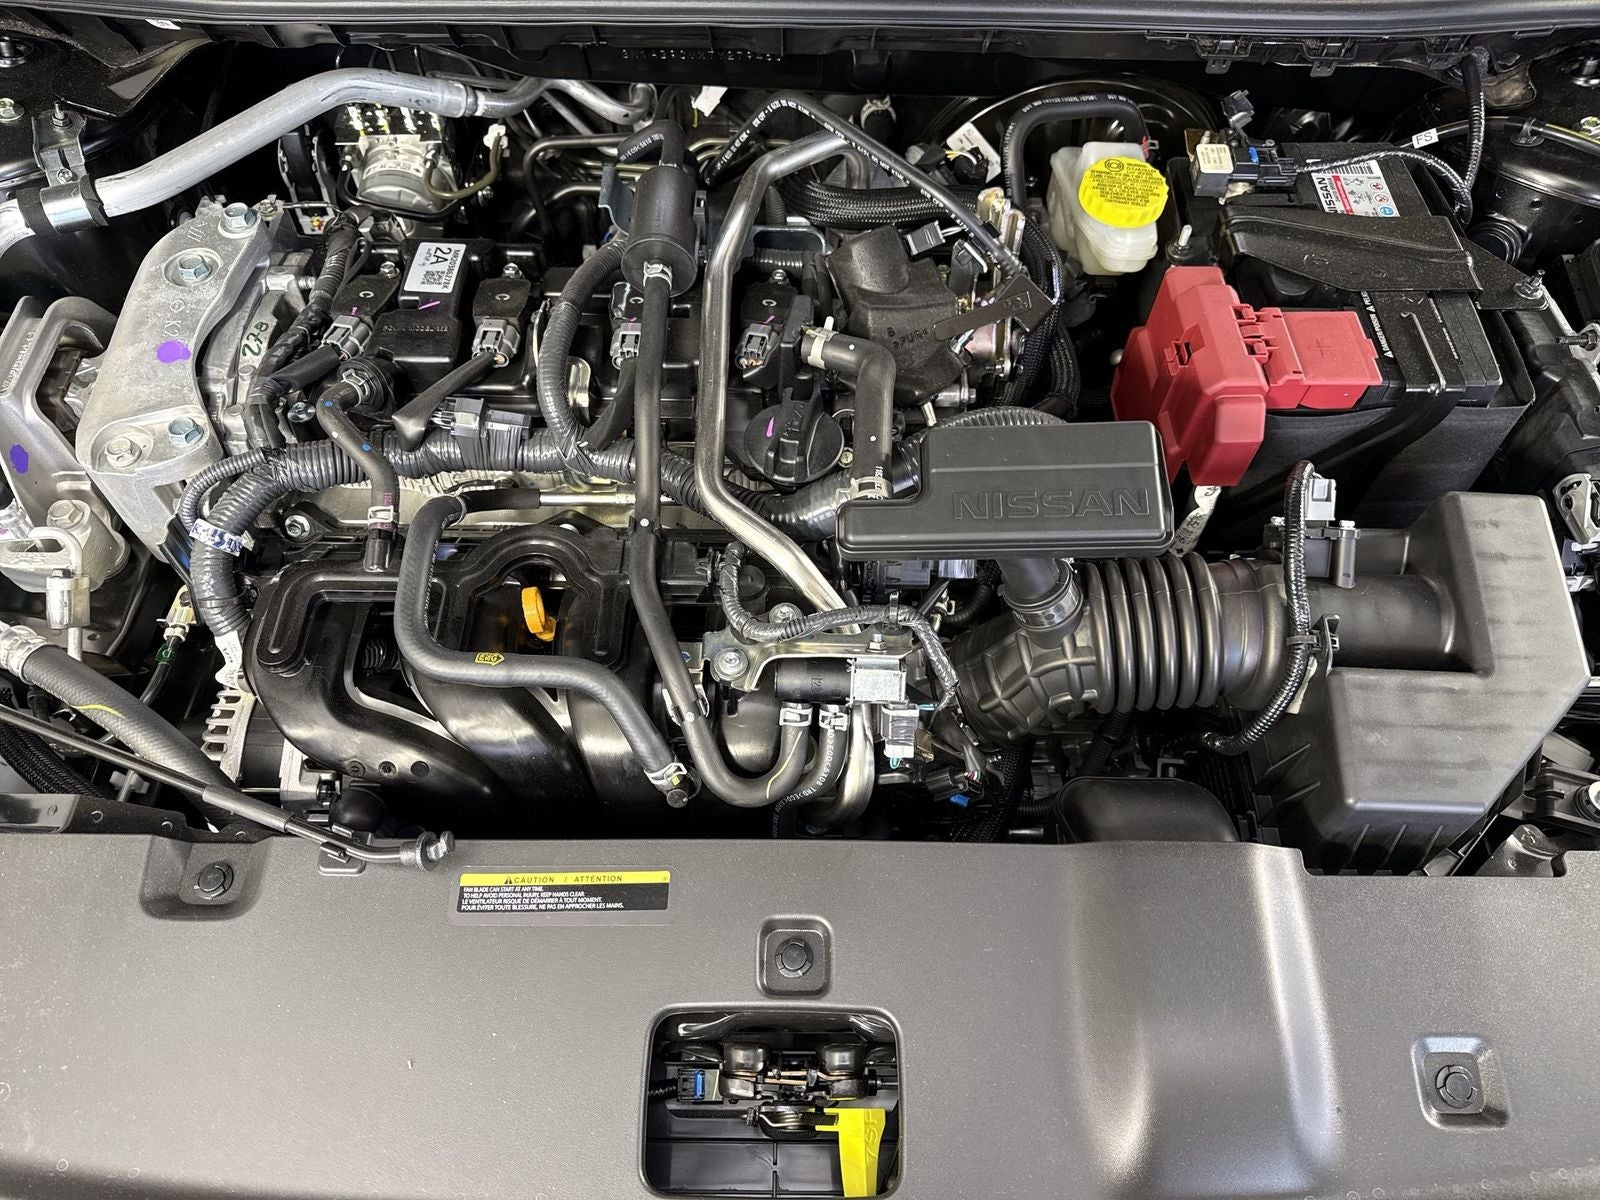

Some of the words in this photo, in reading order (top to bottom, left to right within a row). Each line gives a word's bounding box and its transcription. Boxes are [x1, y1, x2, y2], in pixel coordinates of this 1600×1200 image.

[1416, 131, 1433, 145] FS
[430, 246, 452, 265] 2A
[953, 488, 1150, 520] NISSAN
